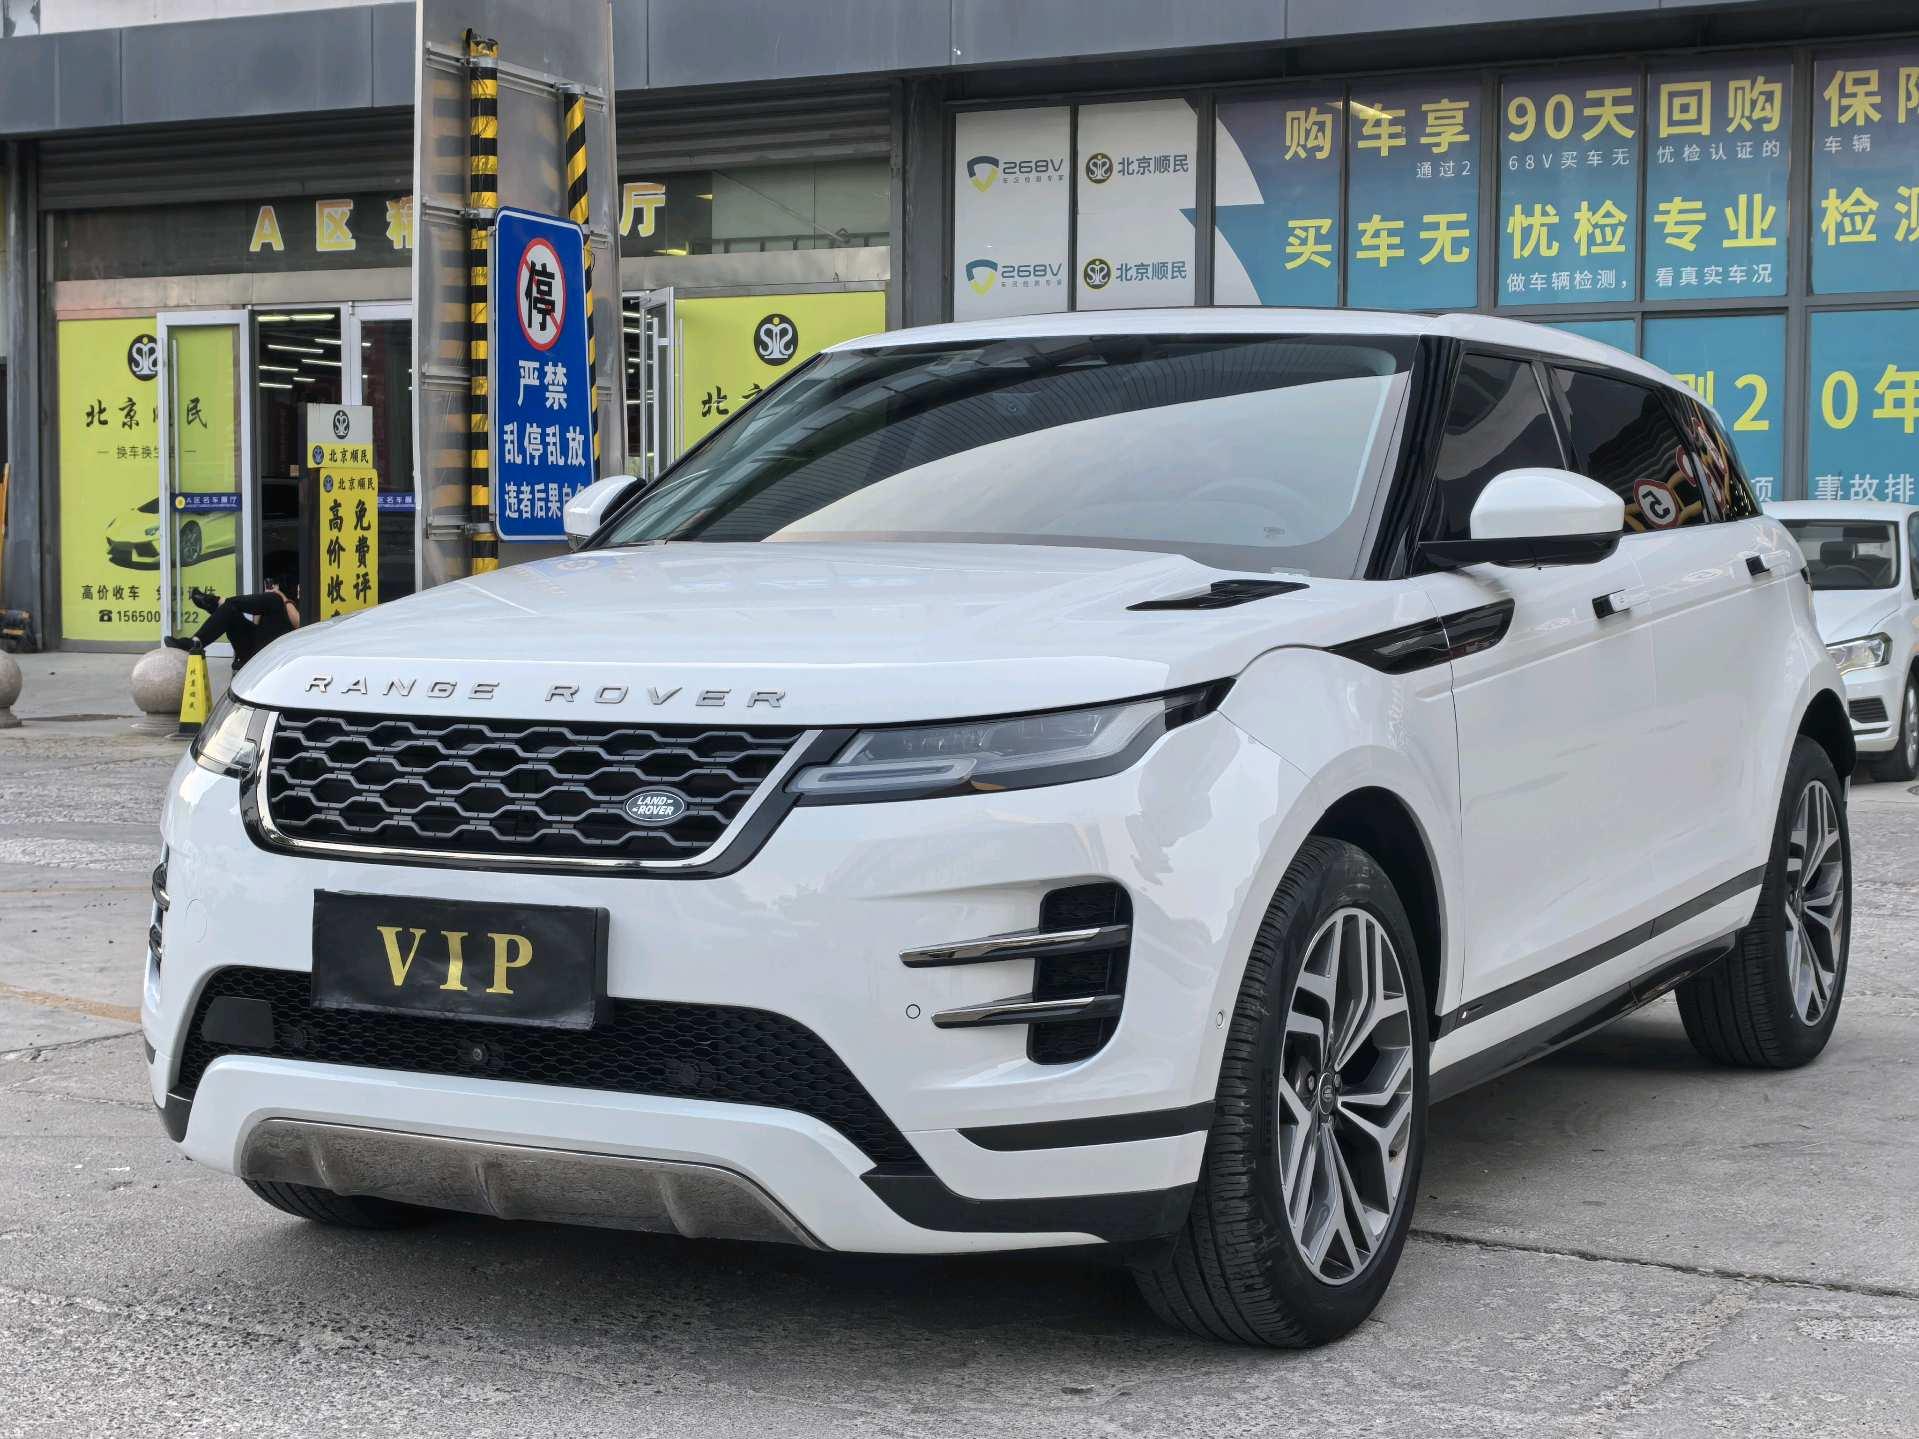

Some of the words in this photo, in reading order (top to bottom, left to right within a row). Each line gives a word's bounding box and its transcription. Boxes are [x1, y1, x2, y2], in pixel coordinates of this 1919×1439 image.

[1003, 159, 1064, 175] 268V
[1118, 154, 1189, 176] 北京顺民
[620, 182, 666, 238] 厅
[1001, 263, 1062, 279] 268V
[1116, 261, 1187, 282] 北京顺民
[524, 261, 556, 331] 停
[517, 360, 567, 410] 严禁
[1675, 364, 1919, 433] 20年
[85, 396, 207, 430] 北京民
[329, 449, 369, 464] 北京顺民
[503, 421, 585, 467] 乱停乱放
[338, 477, 375, 491] 北京顺民
[327, 499, 347, 618] 高价收
[81, 585, 140, 600] 高价收车
[304, 674, 500, 699] RANGE
[545, 684, 786, 707] ROVER
[637, 796, 667, 805] LAND
[637, 806, 674, 815] ROVER
[376, 926, 533, 995] VIP
